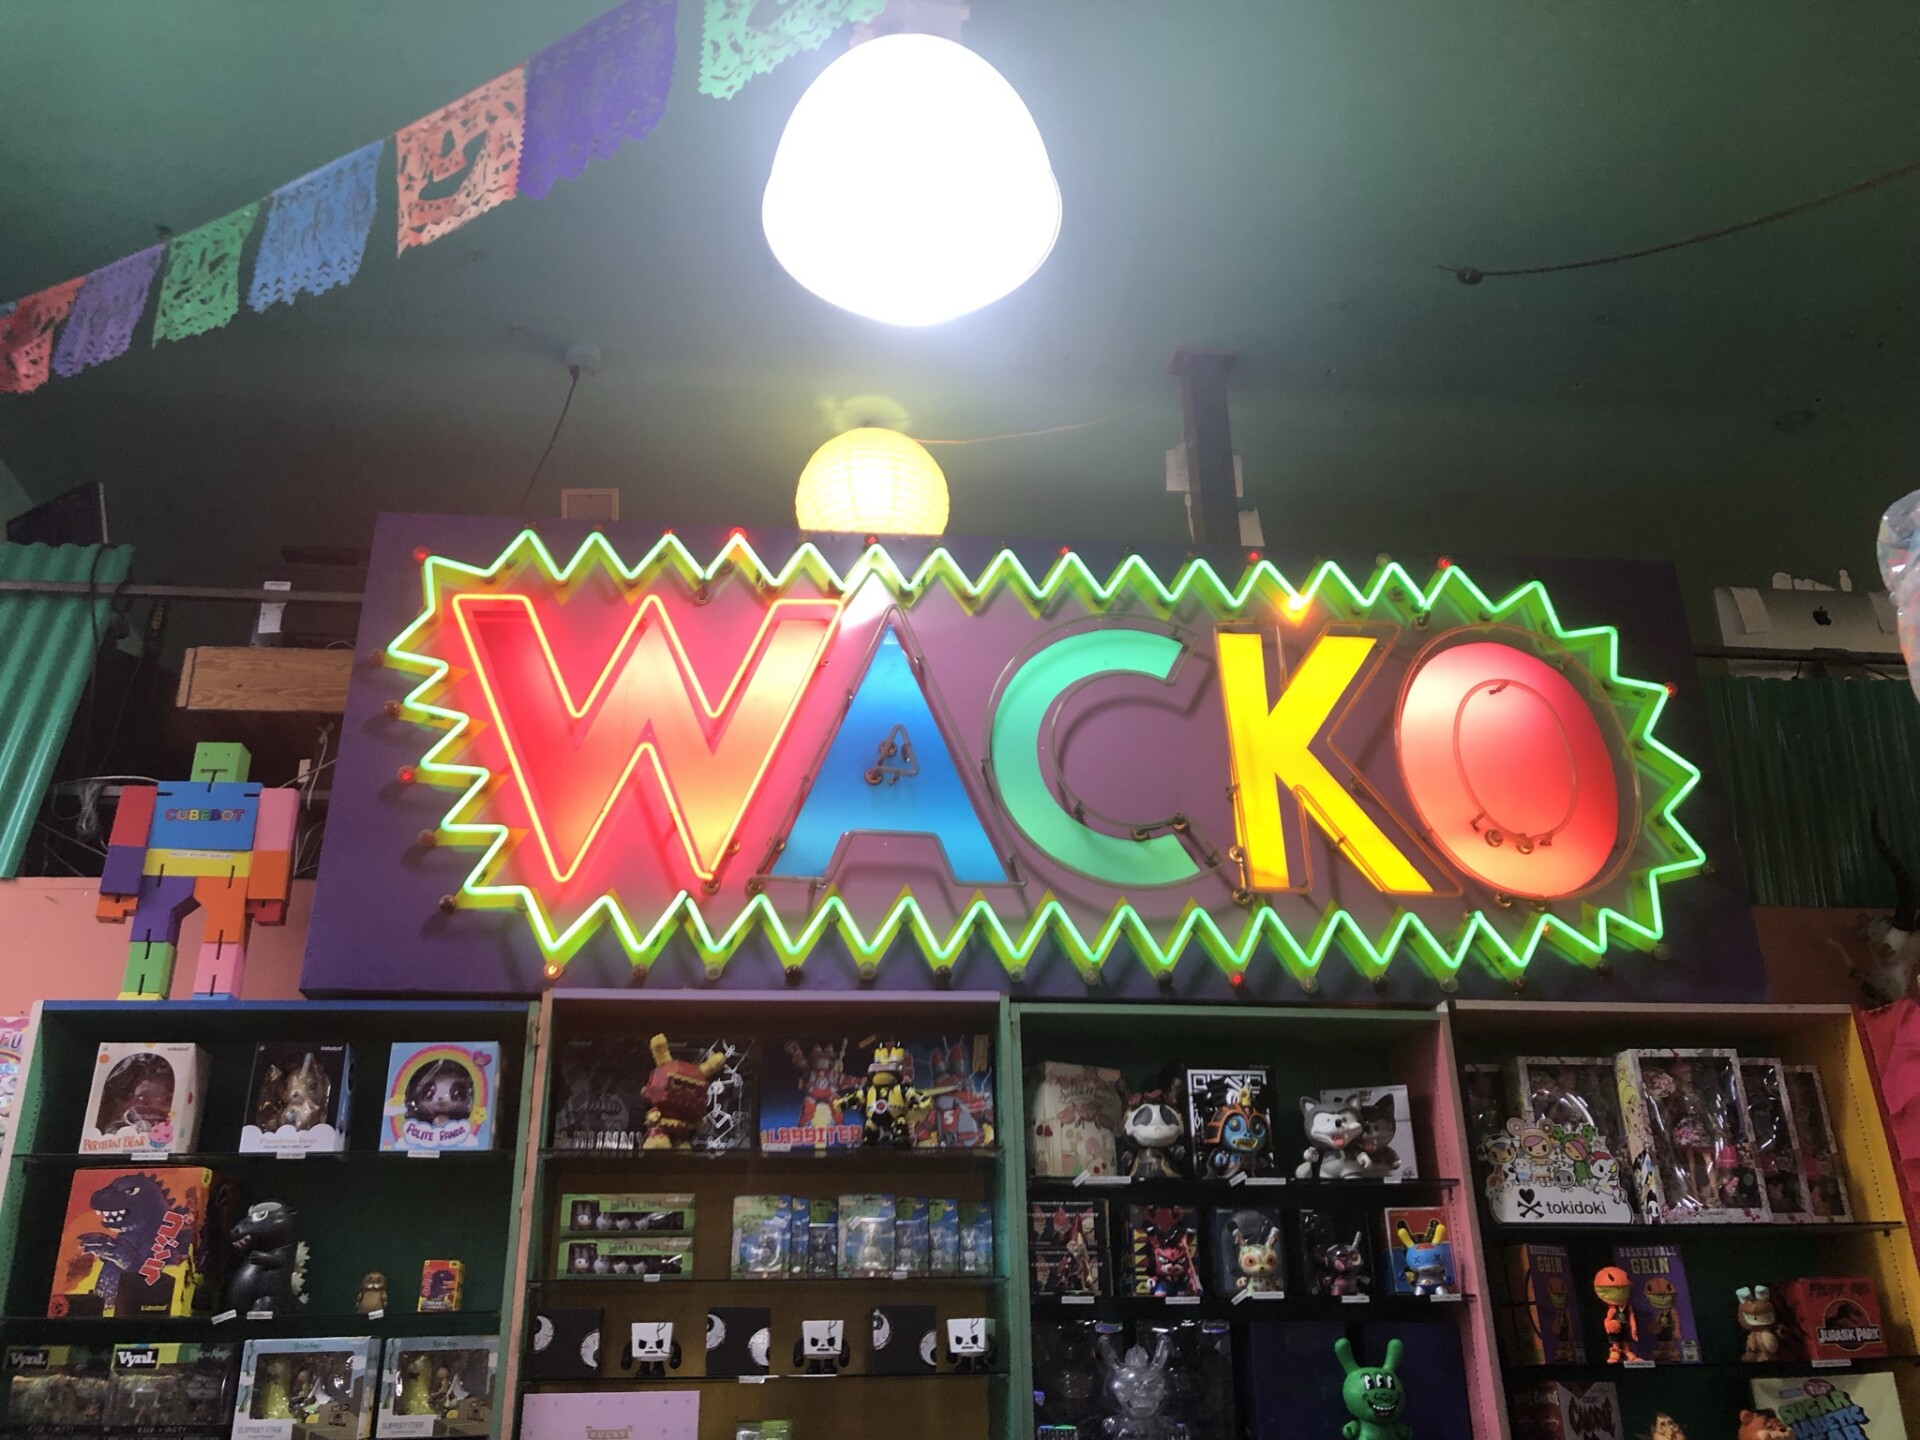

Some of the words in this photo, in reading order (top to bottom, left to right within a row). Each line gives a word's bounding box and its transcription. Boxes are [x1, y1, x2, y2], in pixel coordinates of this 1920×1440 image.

[452, 594, 1630, 902] WACKO
[165, 808, 247, 822] CUBEBOT
[405, 1122, 434, 1142] POLITE
[439, 1125, 466, 1142] PANDA
[1546, 1200, 1607, 1216] tokidoki
[1618, 1246, 1678, 1257] BASKETBALL
[1537, 1256, 1563, 1273] GRIN
[1630, 1257, 1670, 1274] GRIN
[117, 1350, 157, 1368] Vynl.
[1778, 1390, 1853, 1424] SUGAR
